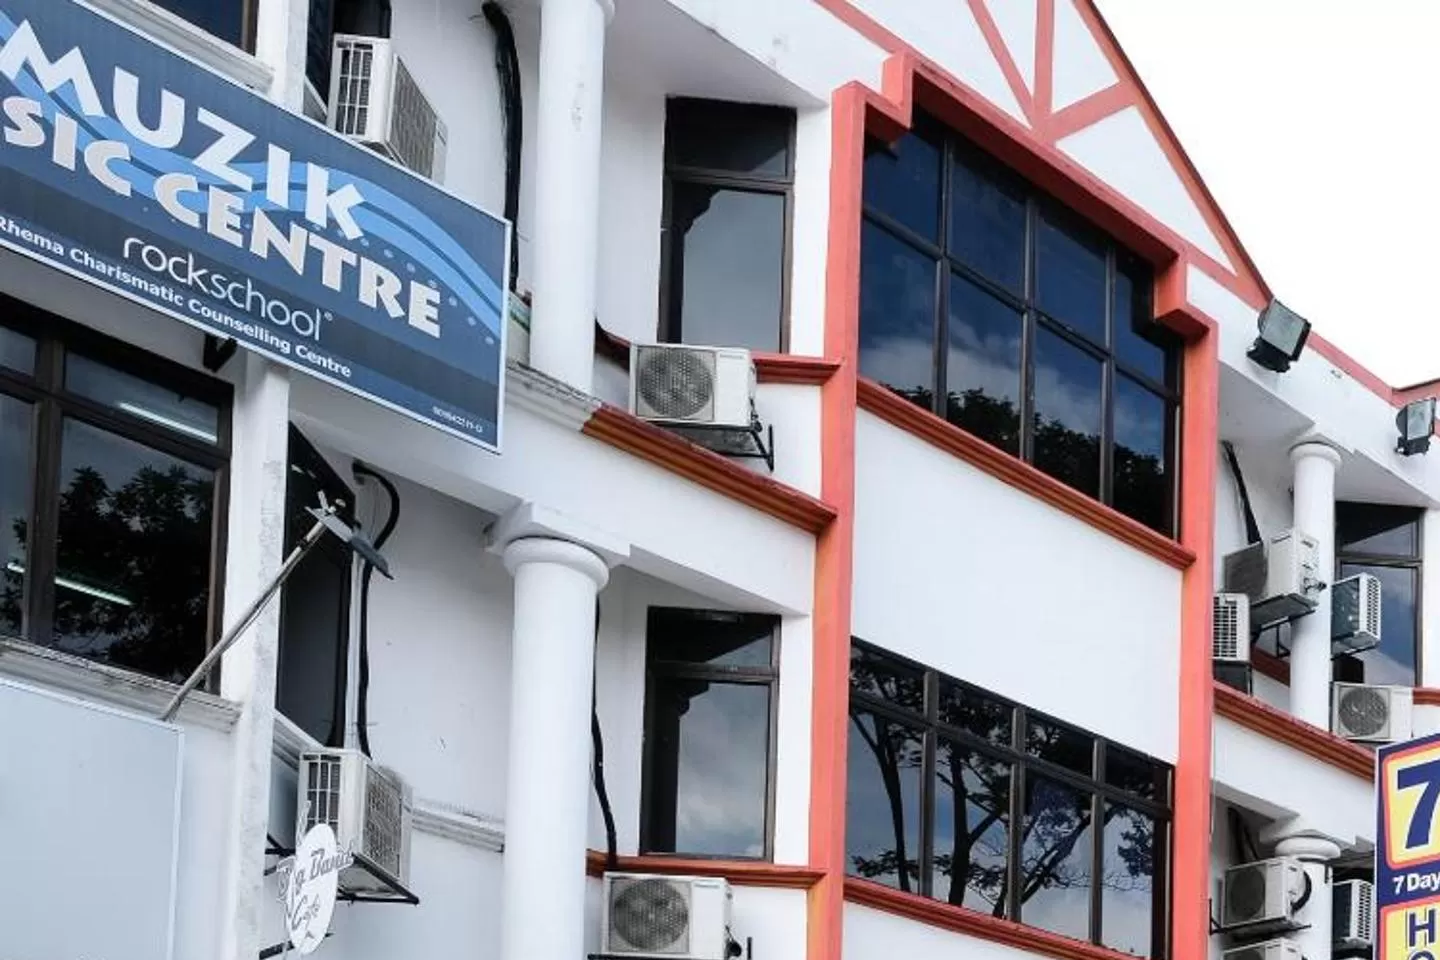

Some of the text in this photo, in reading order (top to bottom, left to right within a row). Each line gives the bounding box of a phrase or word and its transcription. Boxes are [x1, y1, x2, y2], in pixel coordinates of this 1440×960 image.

[0, 19, 366, 241] MUZIK
[70, 248, 184, 306] Charismatic
[188, 299, 291, 354] Counselling
[295, 345, 352, 377] Centre
[153, 172, 441, 339] CENTRE
